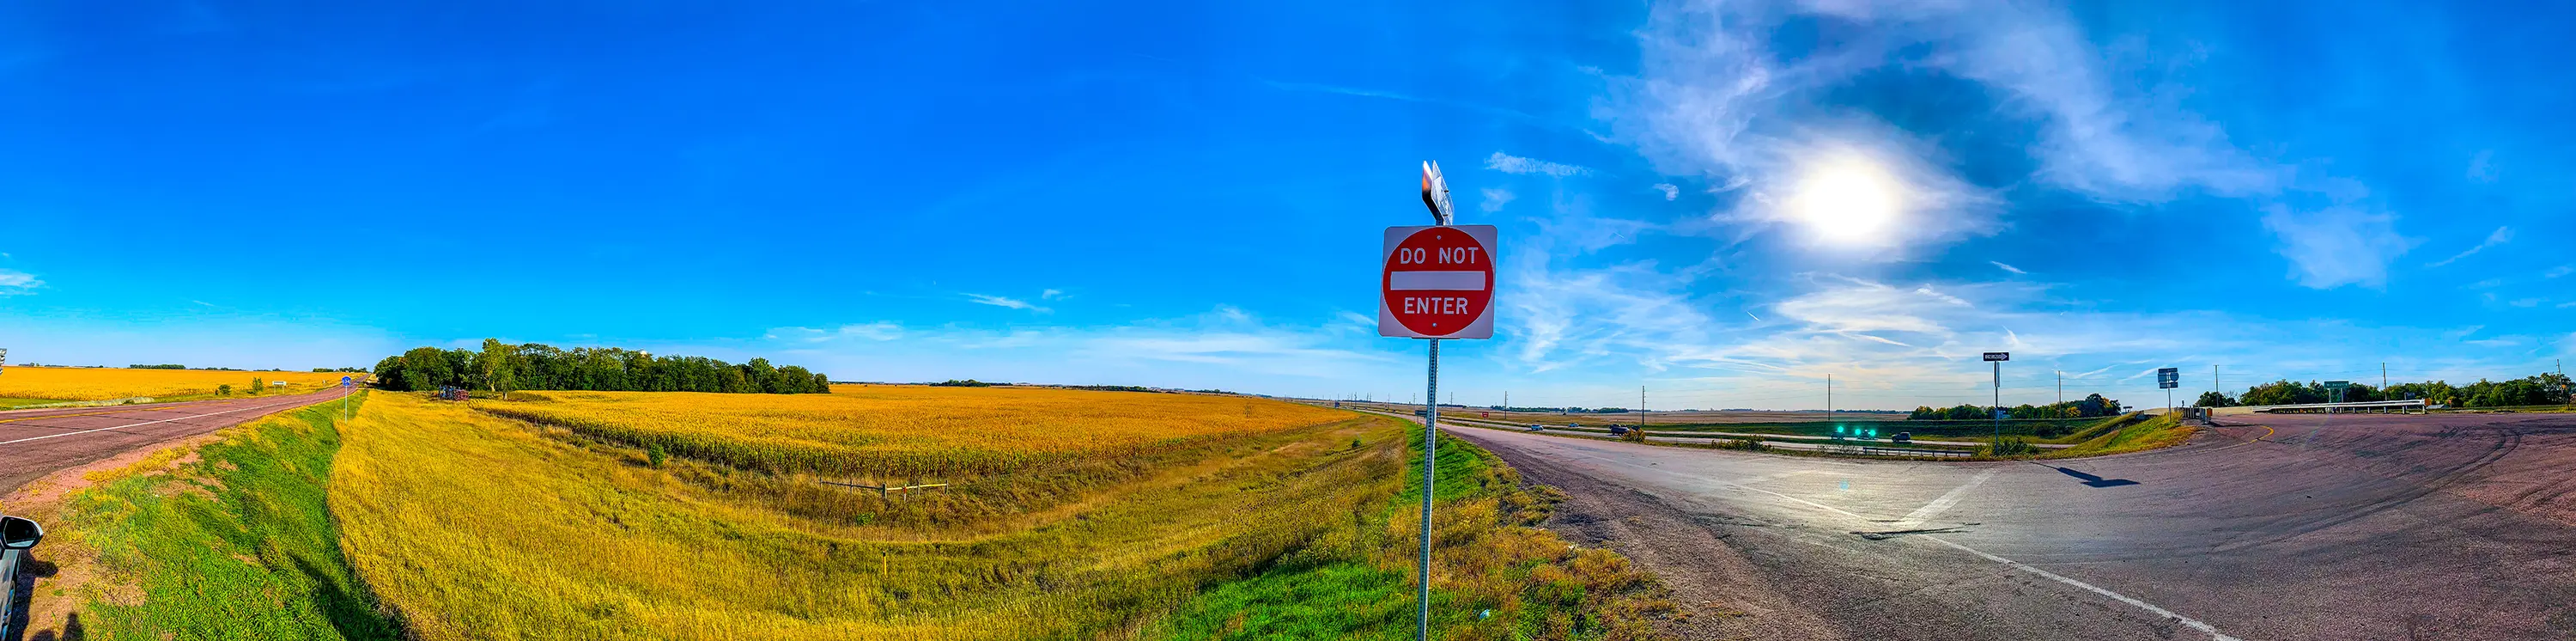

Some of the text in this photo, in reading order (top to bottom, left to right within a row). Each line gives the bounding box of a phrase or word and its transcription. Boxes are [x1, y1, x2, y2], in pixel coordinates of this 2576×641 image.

[1400, 247, 1479, 264] DO NOT
[1404, 297, 1468, 314] ENTER
